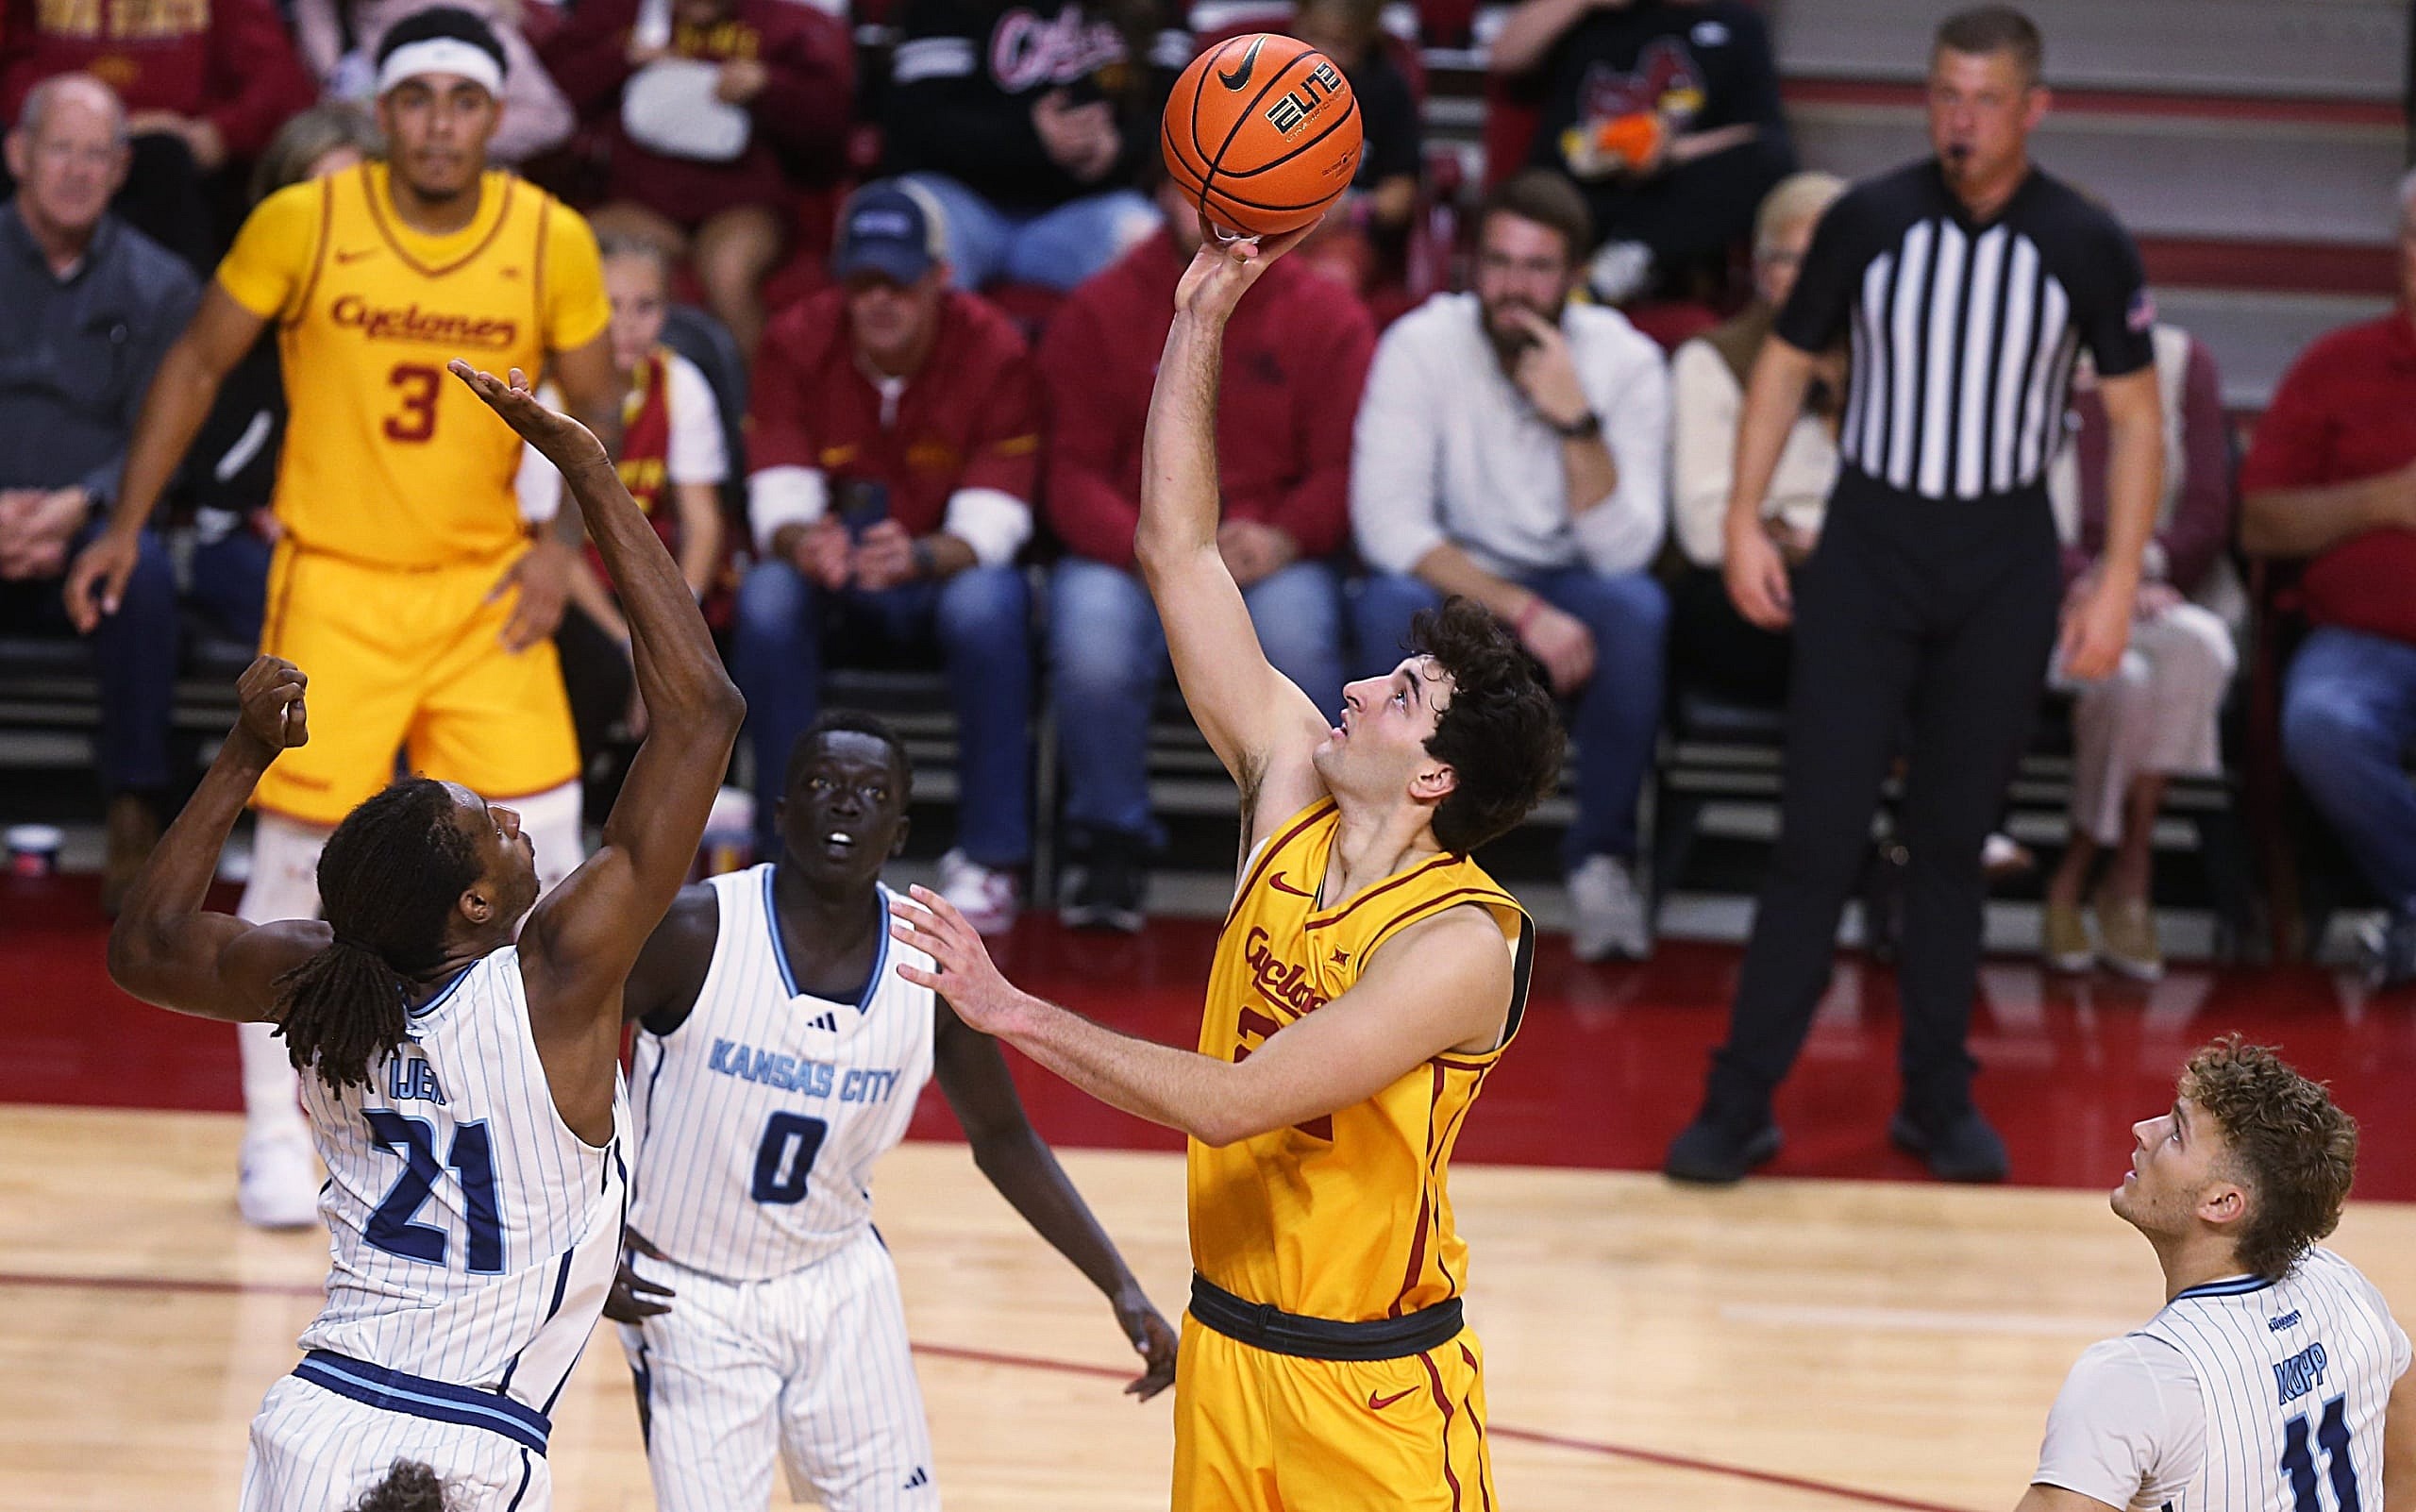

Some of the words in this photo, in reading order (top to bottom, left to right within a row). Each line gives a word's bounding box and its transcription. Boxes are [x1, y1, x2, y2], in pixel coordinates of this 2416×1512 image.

[1265, 60, 1342, 136] ELITE
[331, 295, 517, 350] Cyclones
[383, 362, 442, 443] 3
[709, 1038, 836, 1099] KANSAS
[838, 1067, 901, 1103] CITY
[360, 1107, 507, 1275] 21
[751, 1109, 829, 1205] 0
[2273, 1341, 2327, 1406] KOPP
[2280, 1390, 2360, 1512] 11
